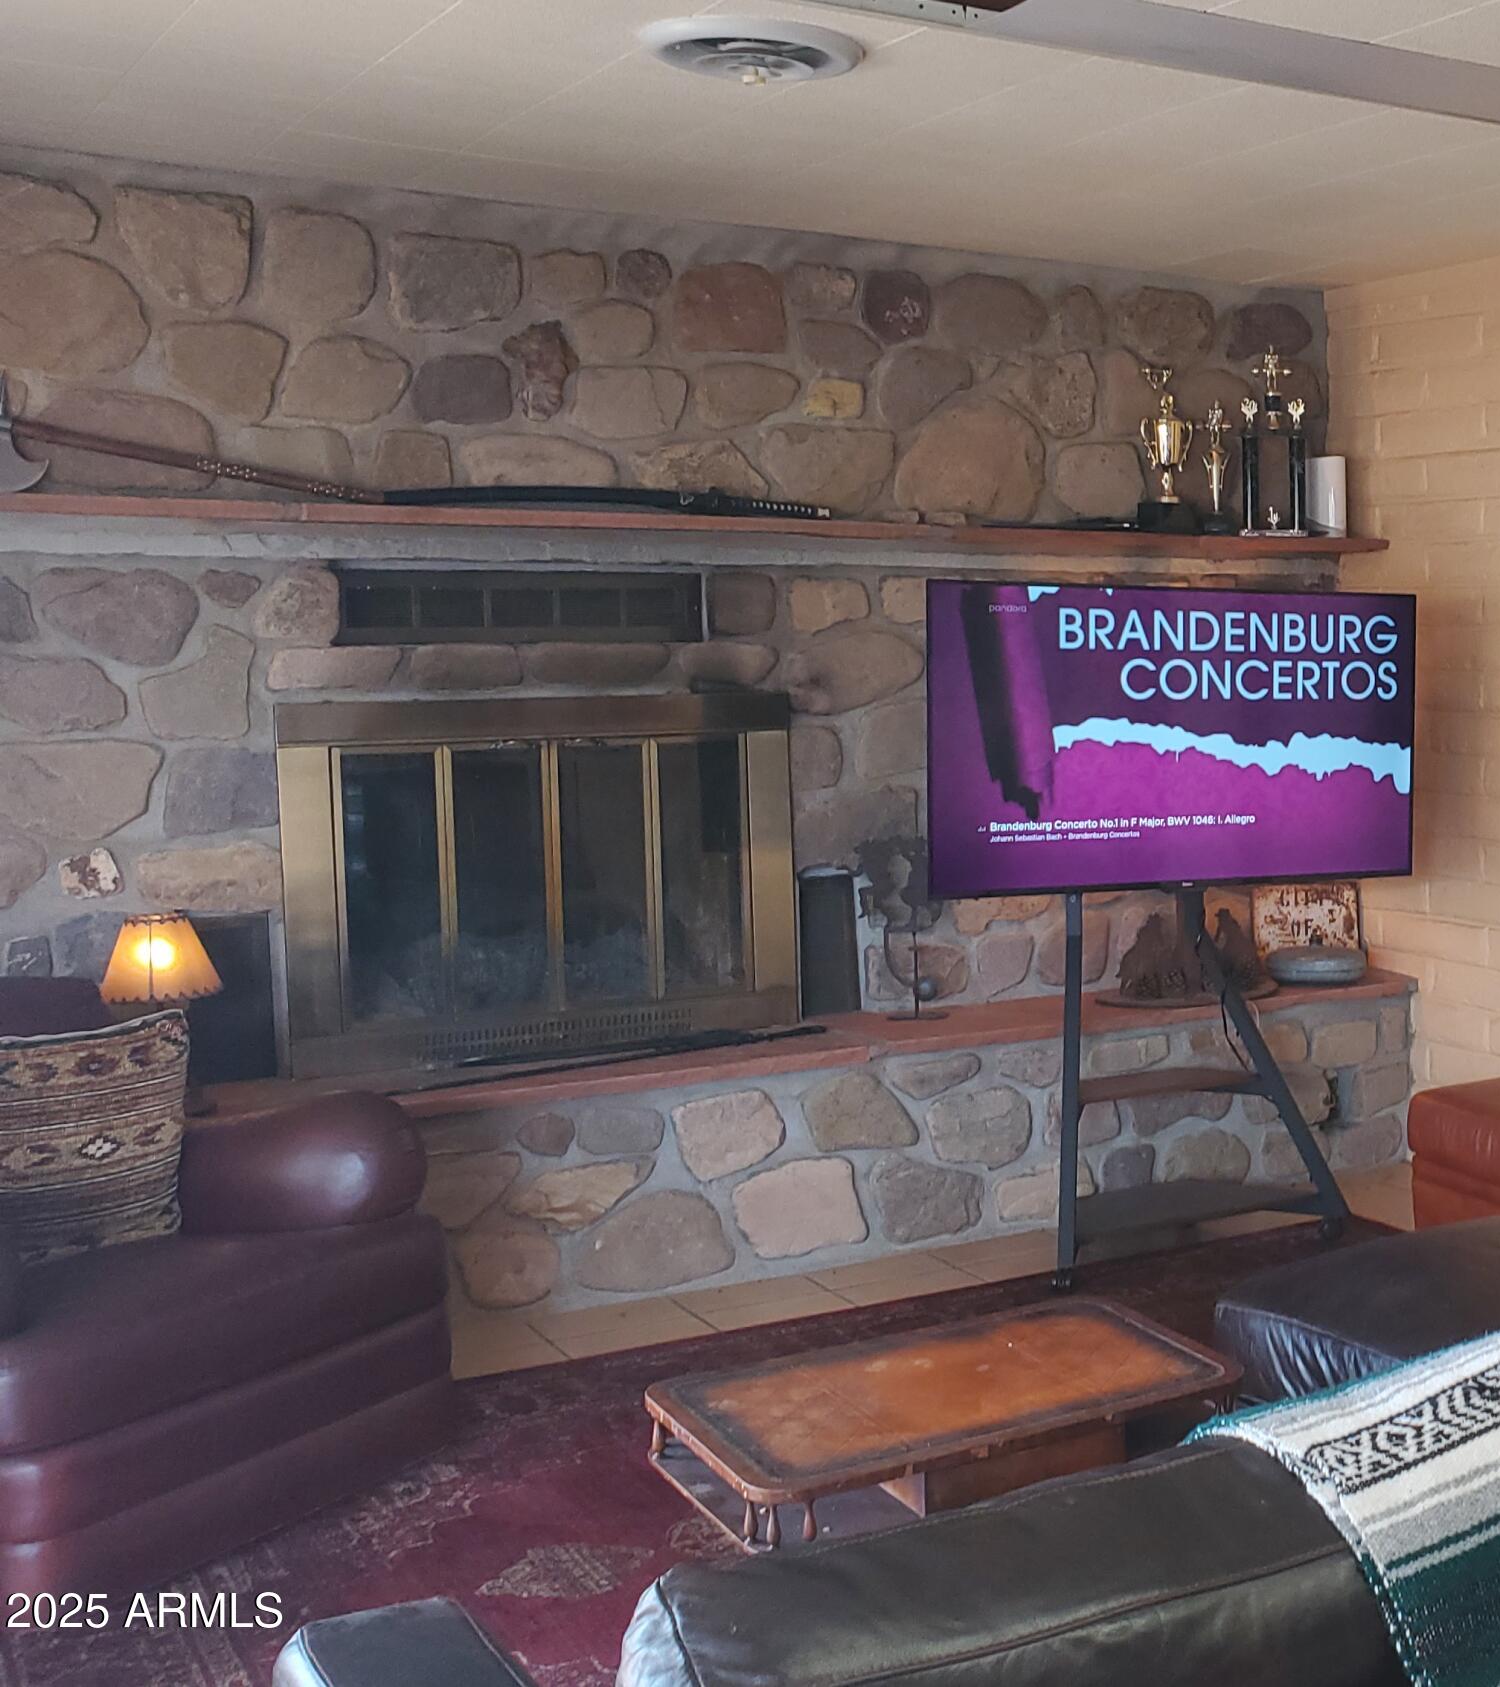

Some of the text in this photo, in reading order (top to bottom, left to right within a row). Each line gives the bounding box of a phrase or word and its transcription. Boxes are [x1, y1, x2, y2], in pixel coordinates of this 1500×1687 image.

[989, 603, 1027, 614] pandora
[1058, 607, 1399, 654] BRANDENBURG
[1120, 658, 1399, 700] CONCERTOS
[990, 820, 1053, 832] Brandenburg
[1054, 819, 1098, 830] Concerto
[1100, 818, 1119, 828] No.1
[1120, 818, 1129, 828] in
[1131, 817, 1137, 827] F
[1139, 816, 1166, 829] Major,
[1167, 816, 1191, 826] BWV
[1192, 815, 1216, 825] 1046:
[1224, 814, 1256, 826] Allegro
[990, 830, 1140, 843] Johann Sebastian Bach Brandenburg Concertos
